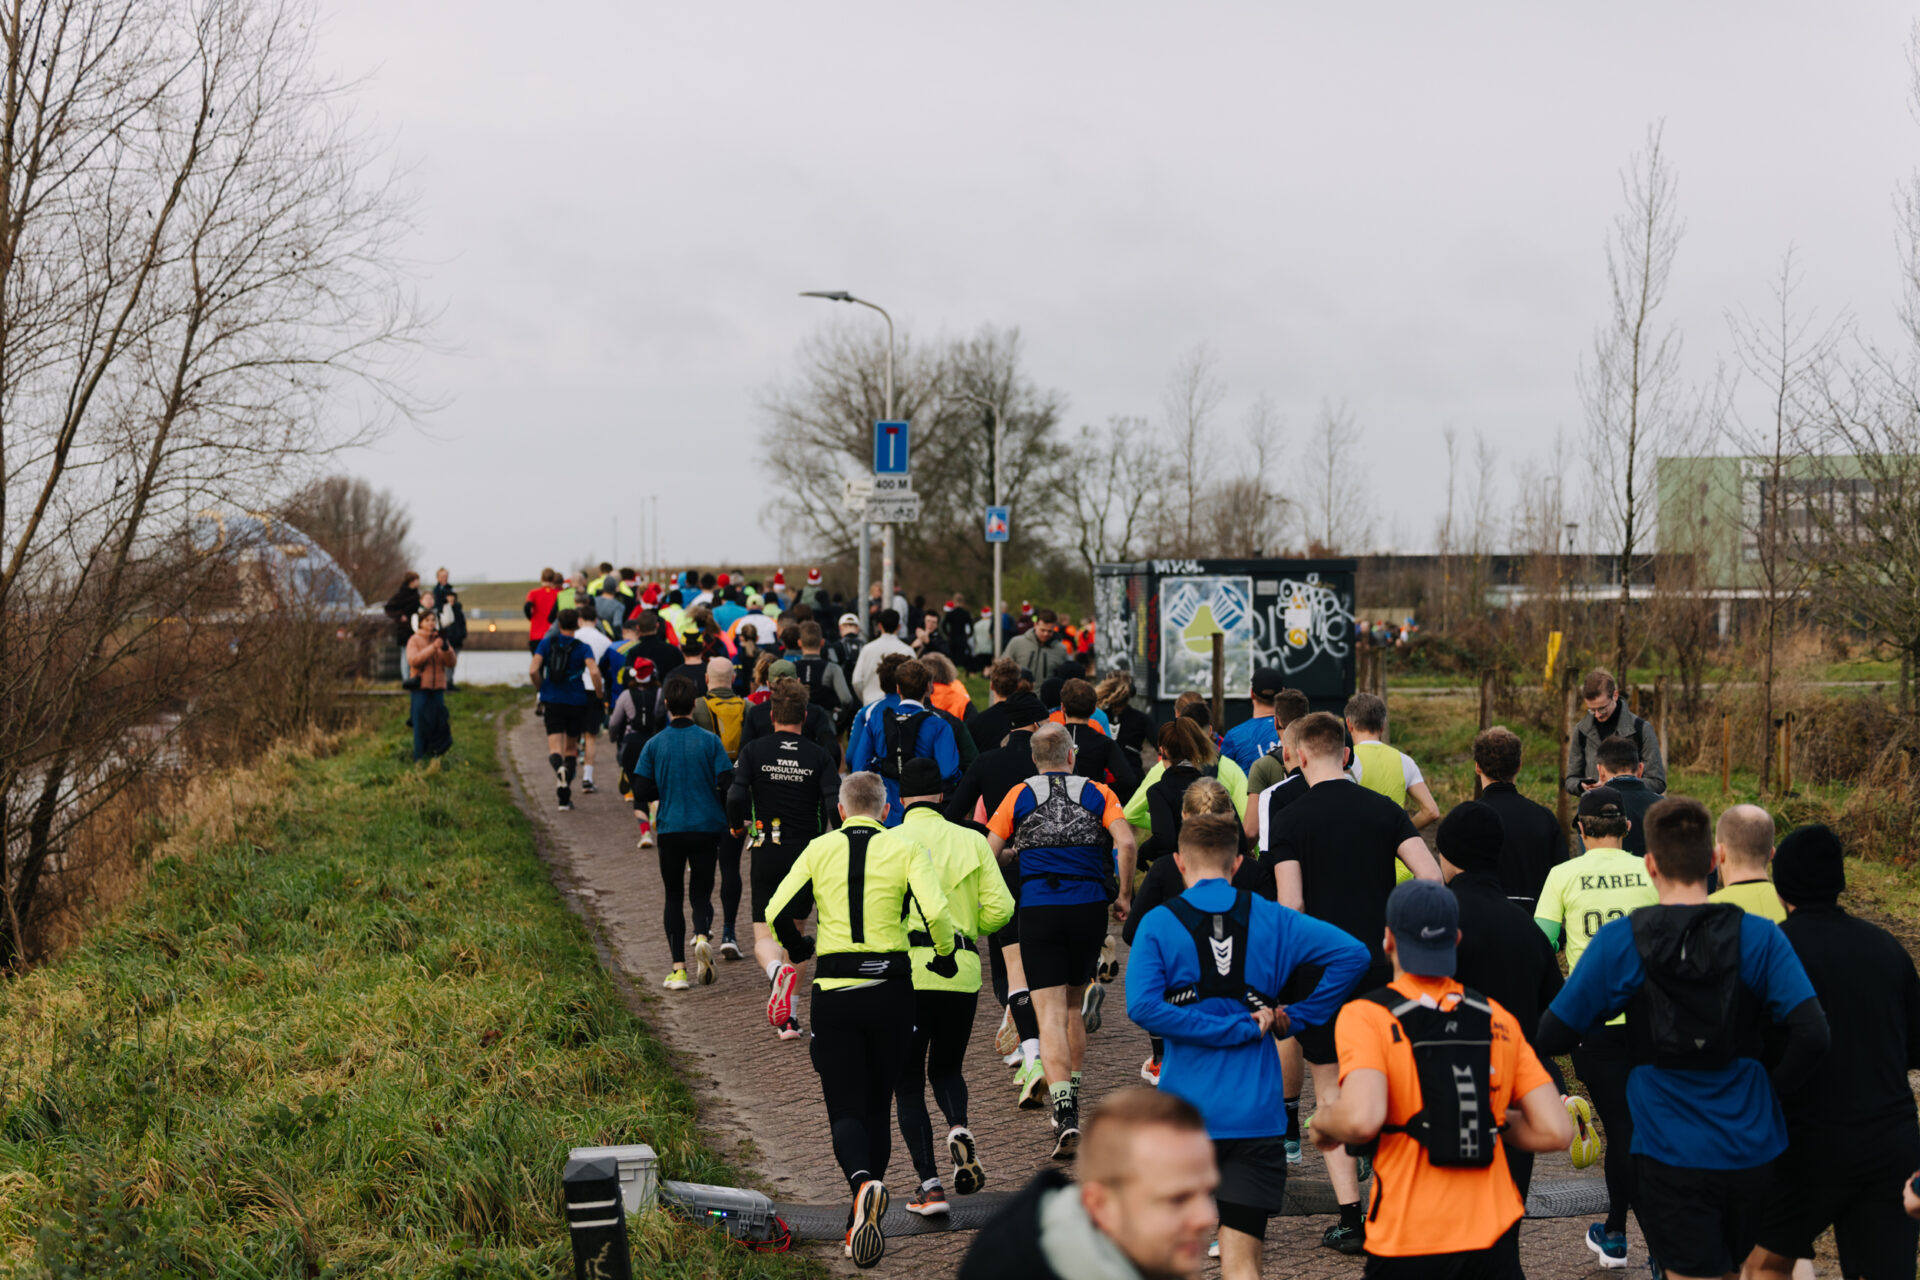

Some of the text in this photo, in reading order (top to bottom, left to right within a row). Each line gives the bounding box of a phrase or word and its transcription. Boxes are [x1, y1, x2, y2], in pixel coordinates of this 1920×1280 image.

[876, 479, 895, 490] 400
[898, 479, 907, 489] M
[776, 758, 799, 768] TATA
[761, 764, 814, 776] CONSULTANCY
[770, 772, 804, 782] SERVICES
[1580, 873, 1647, 890] KAREL
